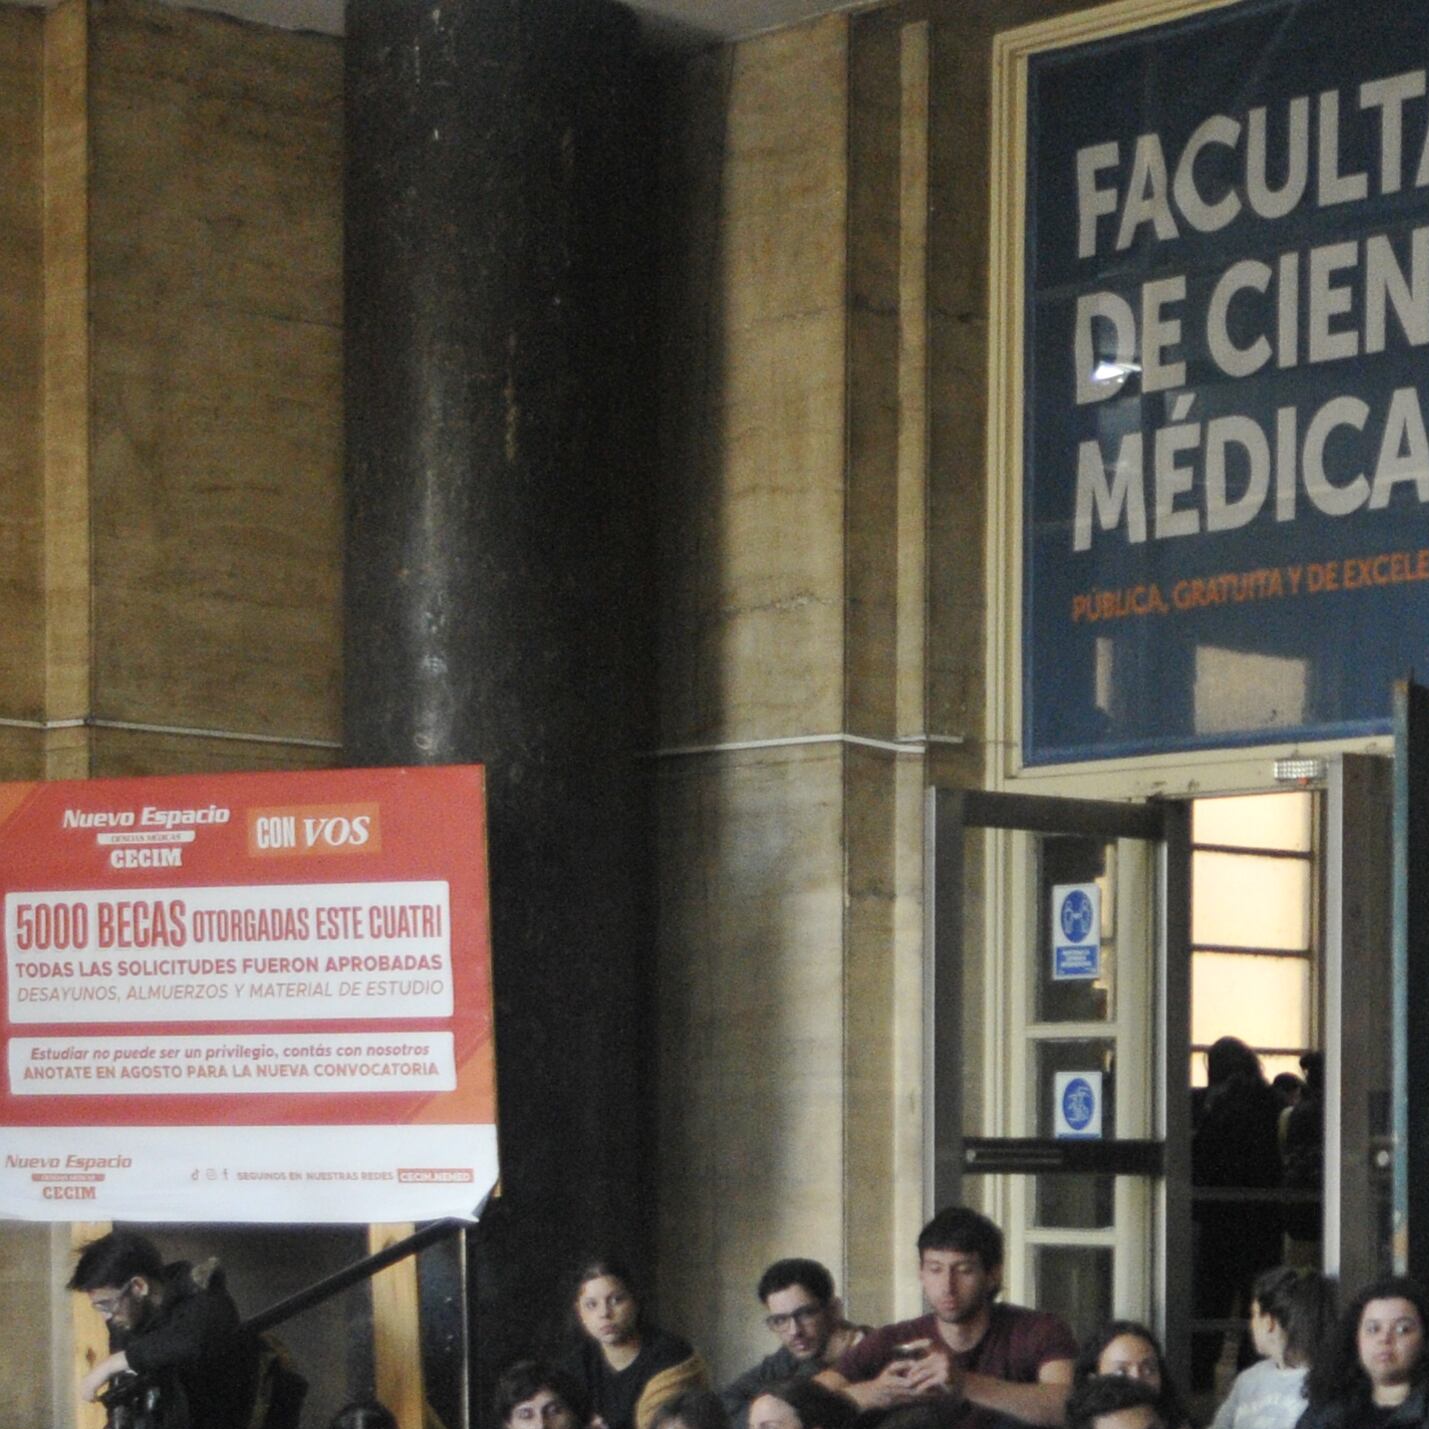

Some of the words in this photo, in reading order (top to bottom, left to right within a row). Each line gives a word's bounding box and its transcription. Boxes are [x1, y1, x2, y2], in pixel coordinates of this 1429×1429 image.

[1075, 275, 1188, 405] DE
[1172, 567, 1284, 608] GRATUITA
[1287, 566, 1302, 594] Y
[1307, 560, 1338, 593] DE
[63, 809, 135, 828] Nuevo
[140, 805, 231, 829] Espacio
[256, 816, 296, 848] CON
[303, 816, 370, 847] VOS
[110, 848, 183, 868] CECIM
[16, 902, 89, 950] 5000
[98, 900, 187, 948] BECAS
[192, 907, 309, 943] OTORGADAS
[316, 906, 363, 939] ESTE
[368, 904, 442, 939] CUATRI
[16, 962, 73, 978] TODAS
[79, 961, 112, 977] LAS
[118, 959, 237, 976] SOLICITUDES
[242, 957, 319, 974] FUERON
[325, 954, 443, 972] APROBADAS
[17, 986, 121, 1003] DESAYUNOS,
[126, 984, 229, 1000] ALMUERZOS
[235, 984, 246, 998] Y
[250, 982, 333, 998] MATERIAL
[339, 982, 362, 997] DE
[366, 980, 445, 996] ESTUDIO
[30, 1046, 90, 1061] Estudiar
[93, 1049, 110, 1060] no
[113, 1046, 157, 1062] puede
[159, 1048, 181, 1059] ser
[184, 1048, 201, 1059] un
[205, 1043, 279, 1061] privilegio,
[282, 1043, 333, 1058] contás
[335, 1047, 362, 1057] con
[366, 1044, 430, 1056] nosotros
[24, 1065, 92, 1080] ANOTATE
[96, 1065, 116, 1079] EN
[120, 1065, 183, 1079] AGOSTO
[187, 1064, 228, 1078] PARA
[233, 1064, 251, 1077] LA
[256, 1063, 309, 1077] NUEVA
[314, 1062, 439, 1076] CONVOCATORIA
[5, 1155, 60, 1168] Nuevo
[66, 1155, 133, 1171] Espacio
[306, 1171, 358, 1180] NUESTRAS
[361, 1171, 393, 1180] REDES
[43, 1186, 96, 1199] CECIM
